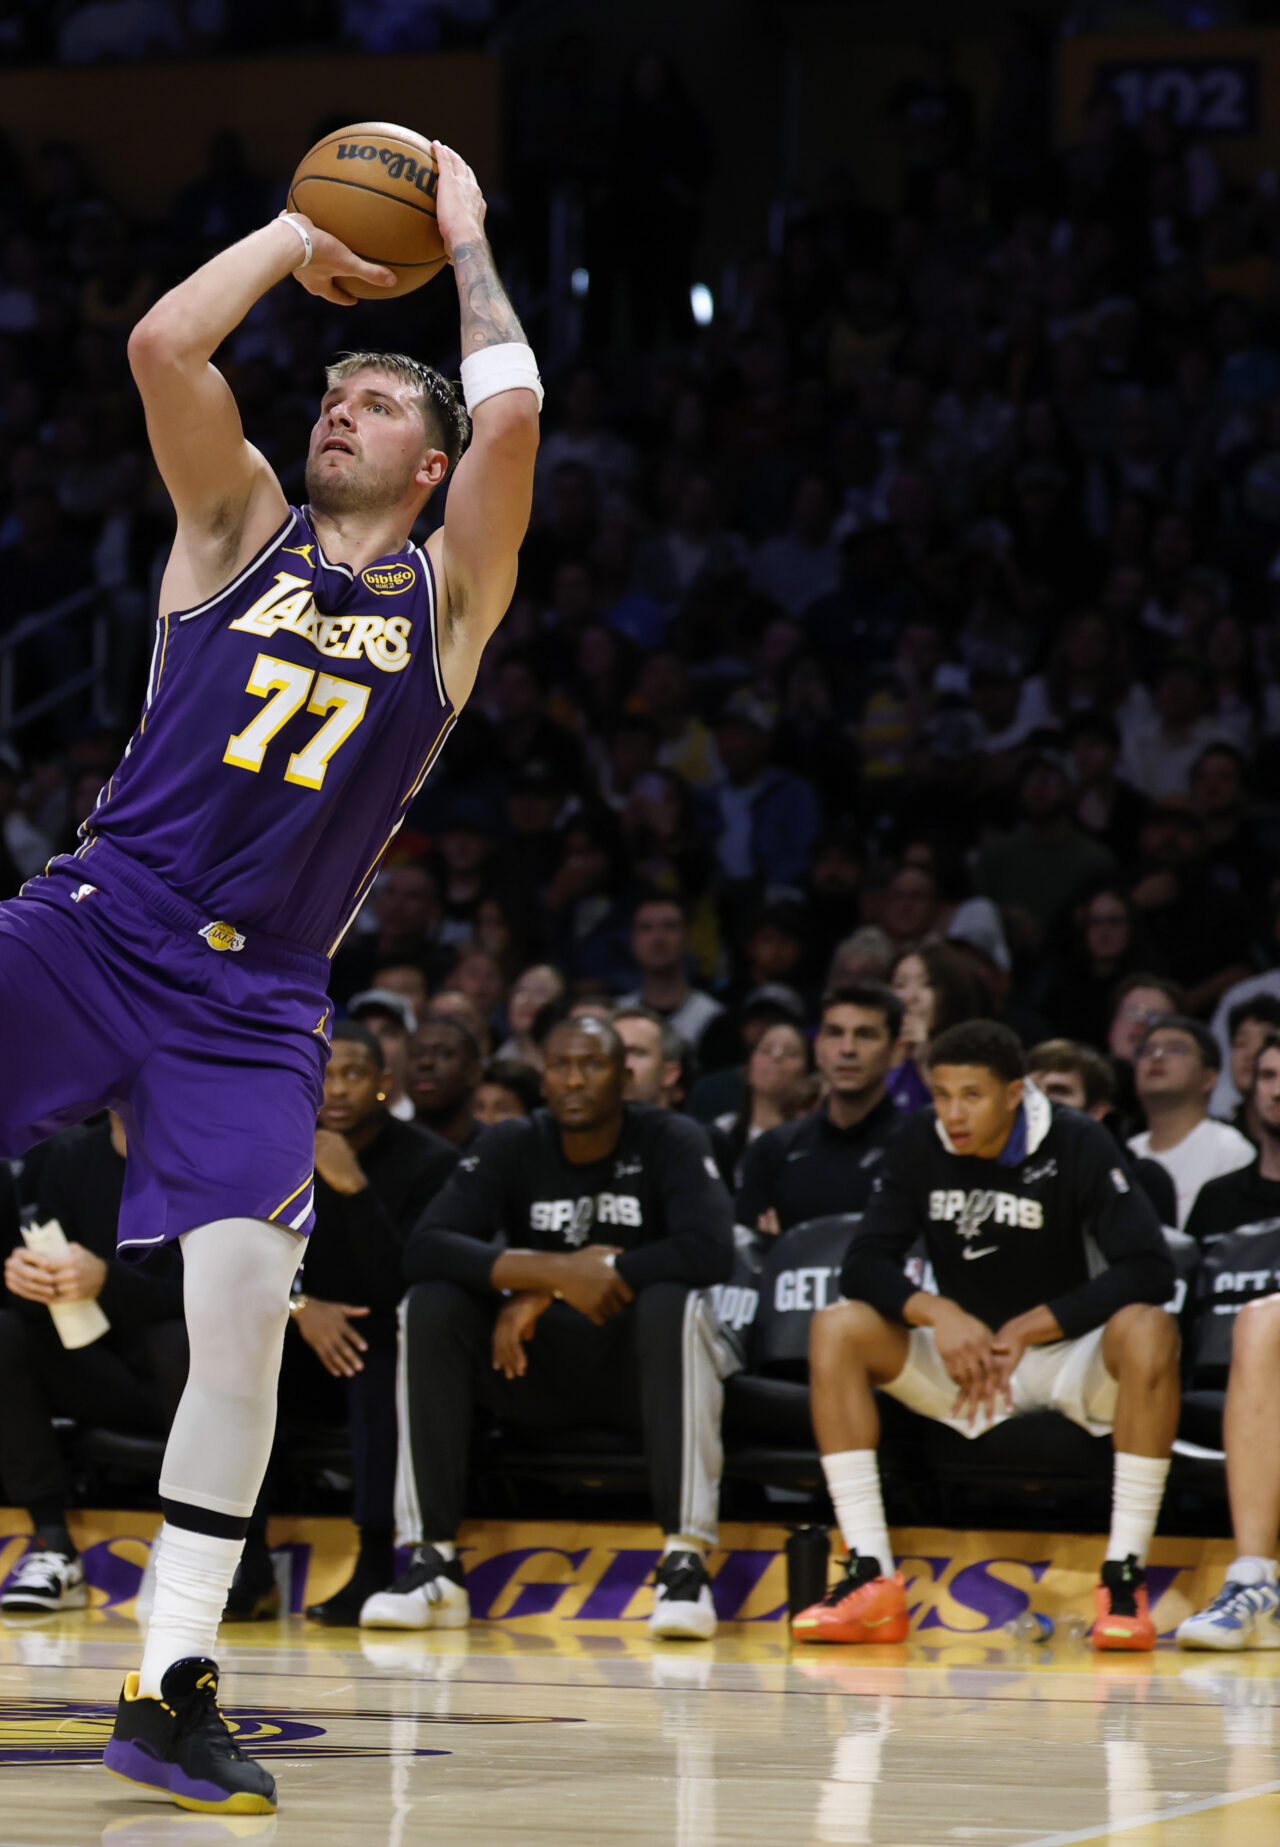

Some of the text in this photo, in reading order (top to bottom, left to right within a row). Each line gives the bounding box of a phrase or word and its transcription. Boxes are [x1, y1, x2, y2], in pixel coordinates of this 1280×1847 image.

[1112, 66, 1247, 129] 102
[365, 571, 412, 585] bibigo
[228, 571, 413, 673] LAKERS
[222, 652, 372, 791] 77
[774, 1267, 832, 1313] GET
